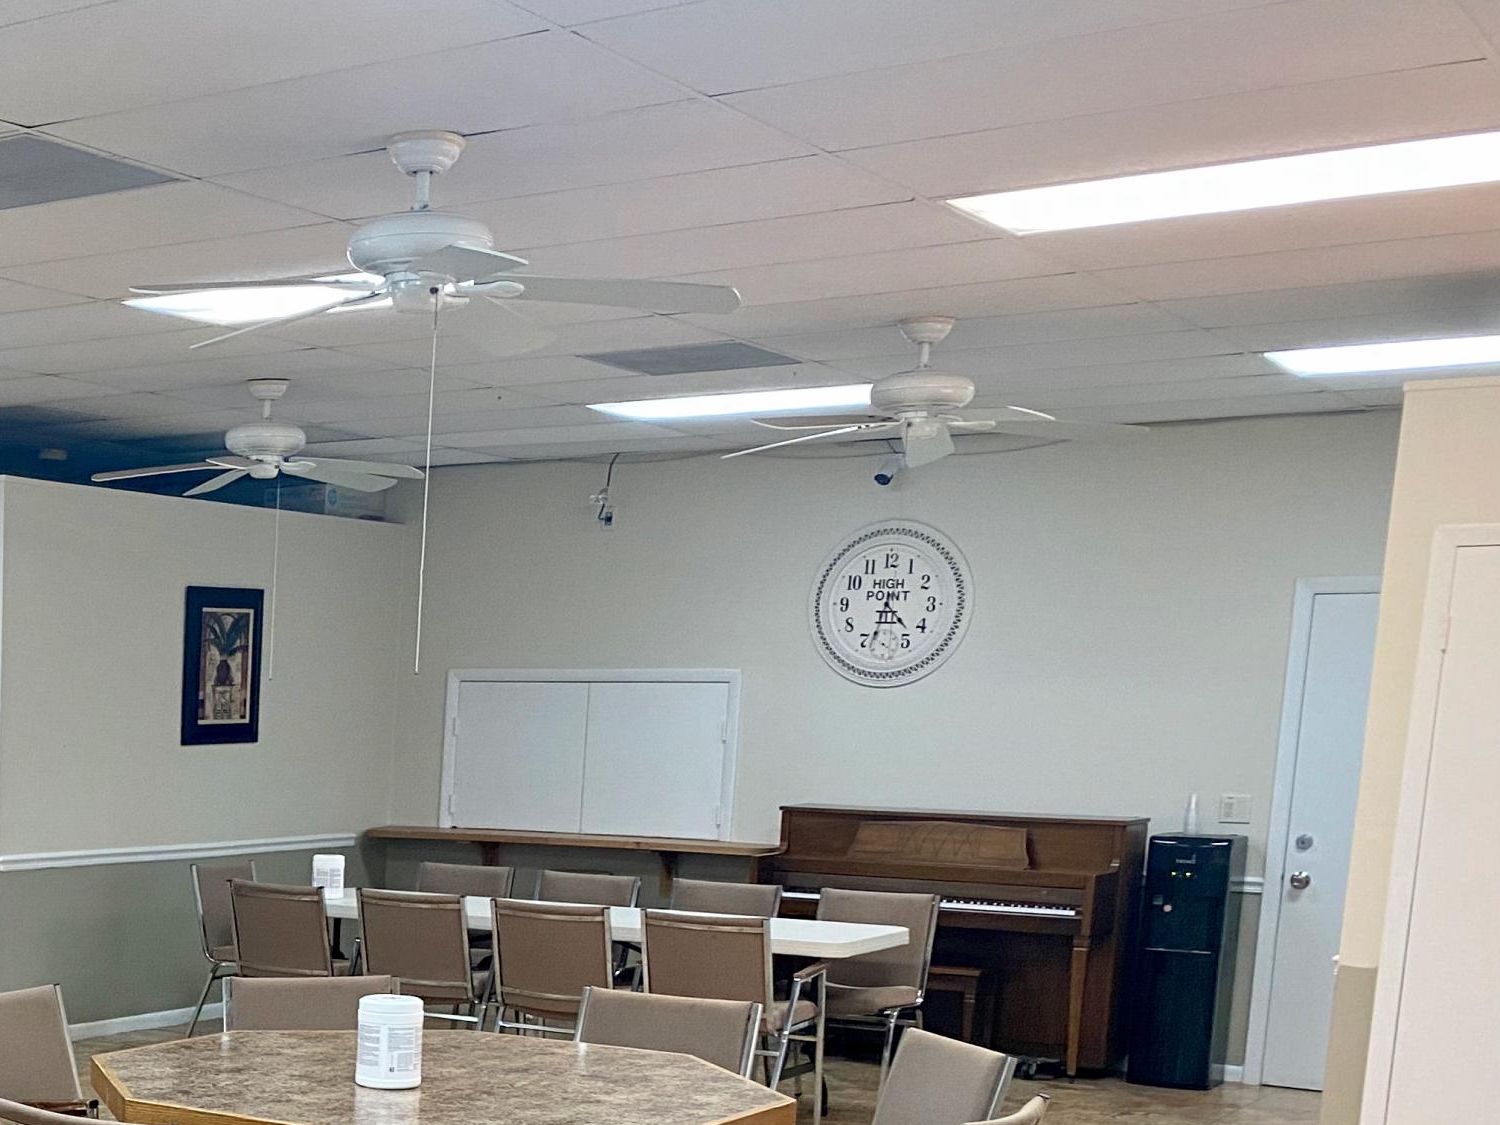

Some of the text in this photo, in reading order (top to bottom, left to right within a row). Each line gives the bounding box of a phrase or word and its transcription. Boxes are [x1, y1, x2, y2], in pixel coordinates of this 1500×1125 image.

[865, 559, 876, 574] 11
[884, 553, 900, 569] 12
[909, 559, 913, 574] 1
[847, 575, 862, 590] 10
[872, 578, 905, 589] HIGH
[921, 574, 930, 590] 2
[866, 590, 911, 601] POINT
[840, 597, 849, 612] 9
[926, 596, 936, 612] 3
[845, 617, 854, 633] 8
[916, 618, 927, 633] 4
[860, 633, 870, 648] 7
[901, 634, 910, 649] 5
